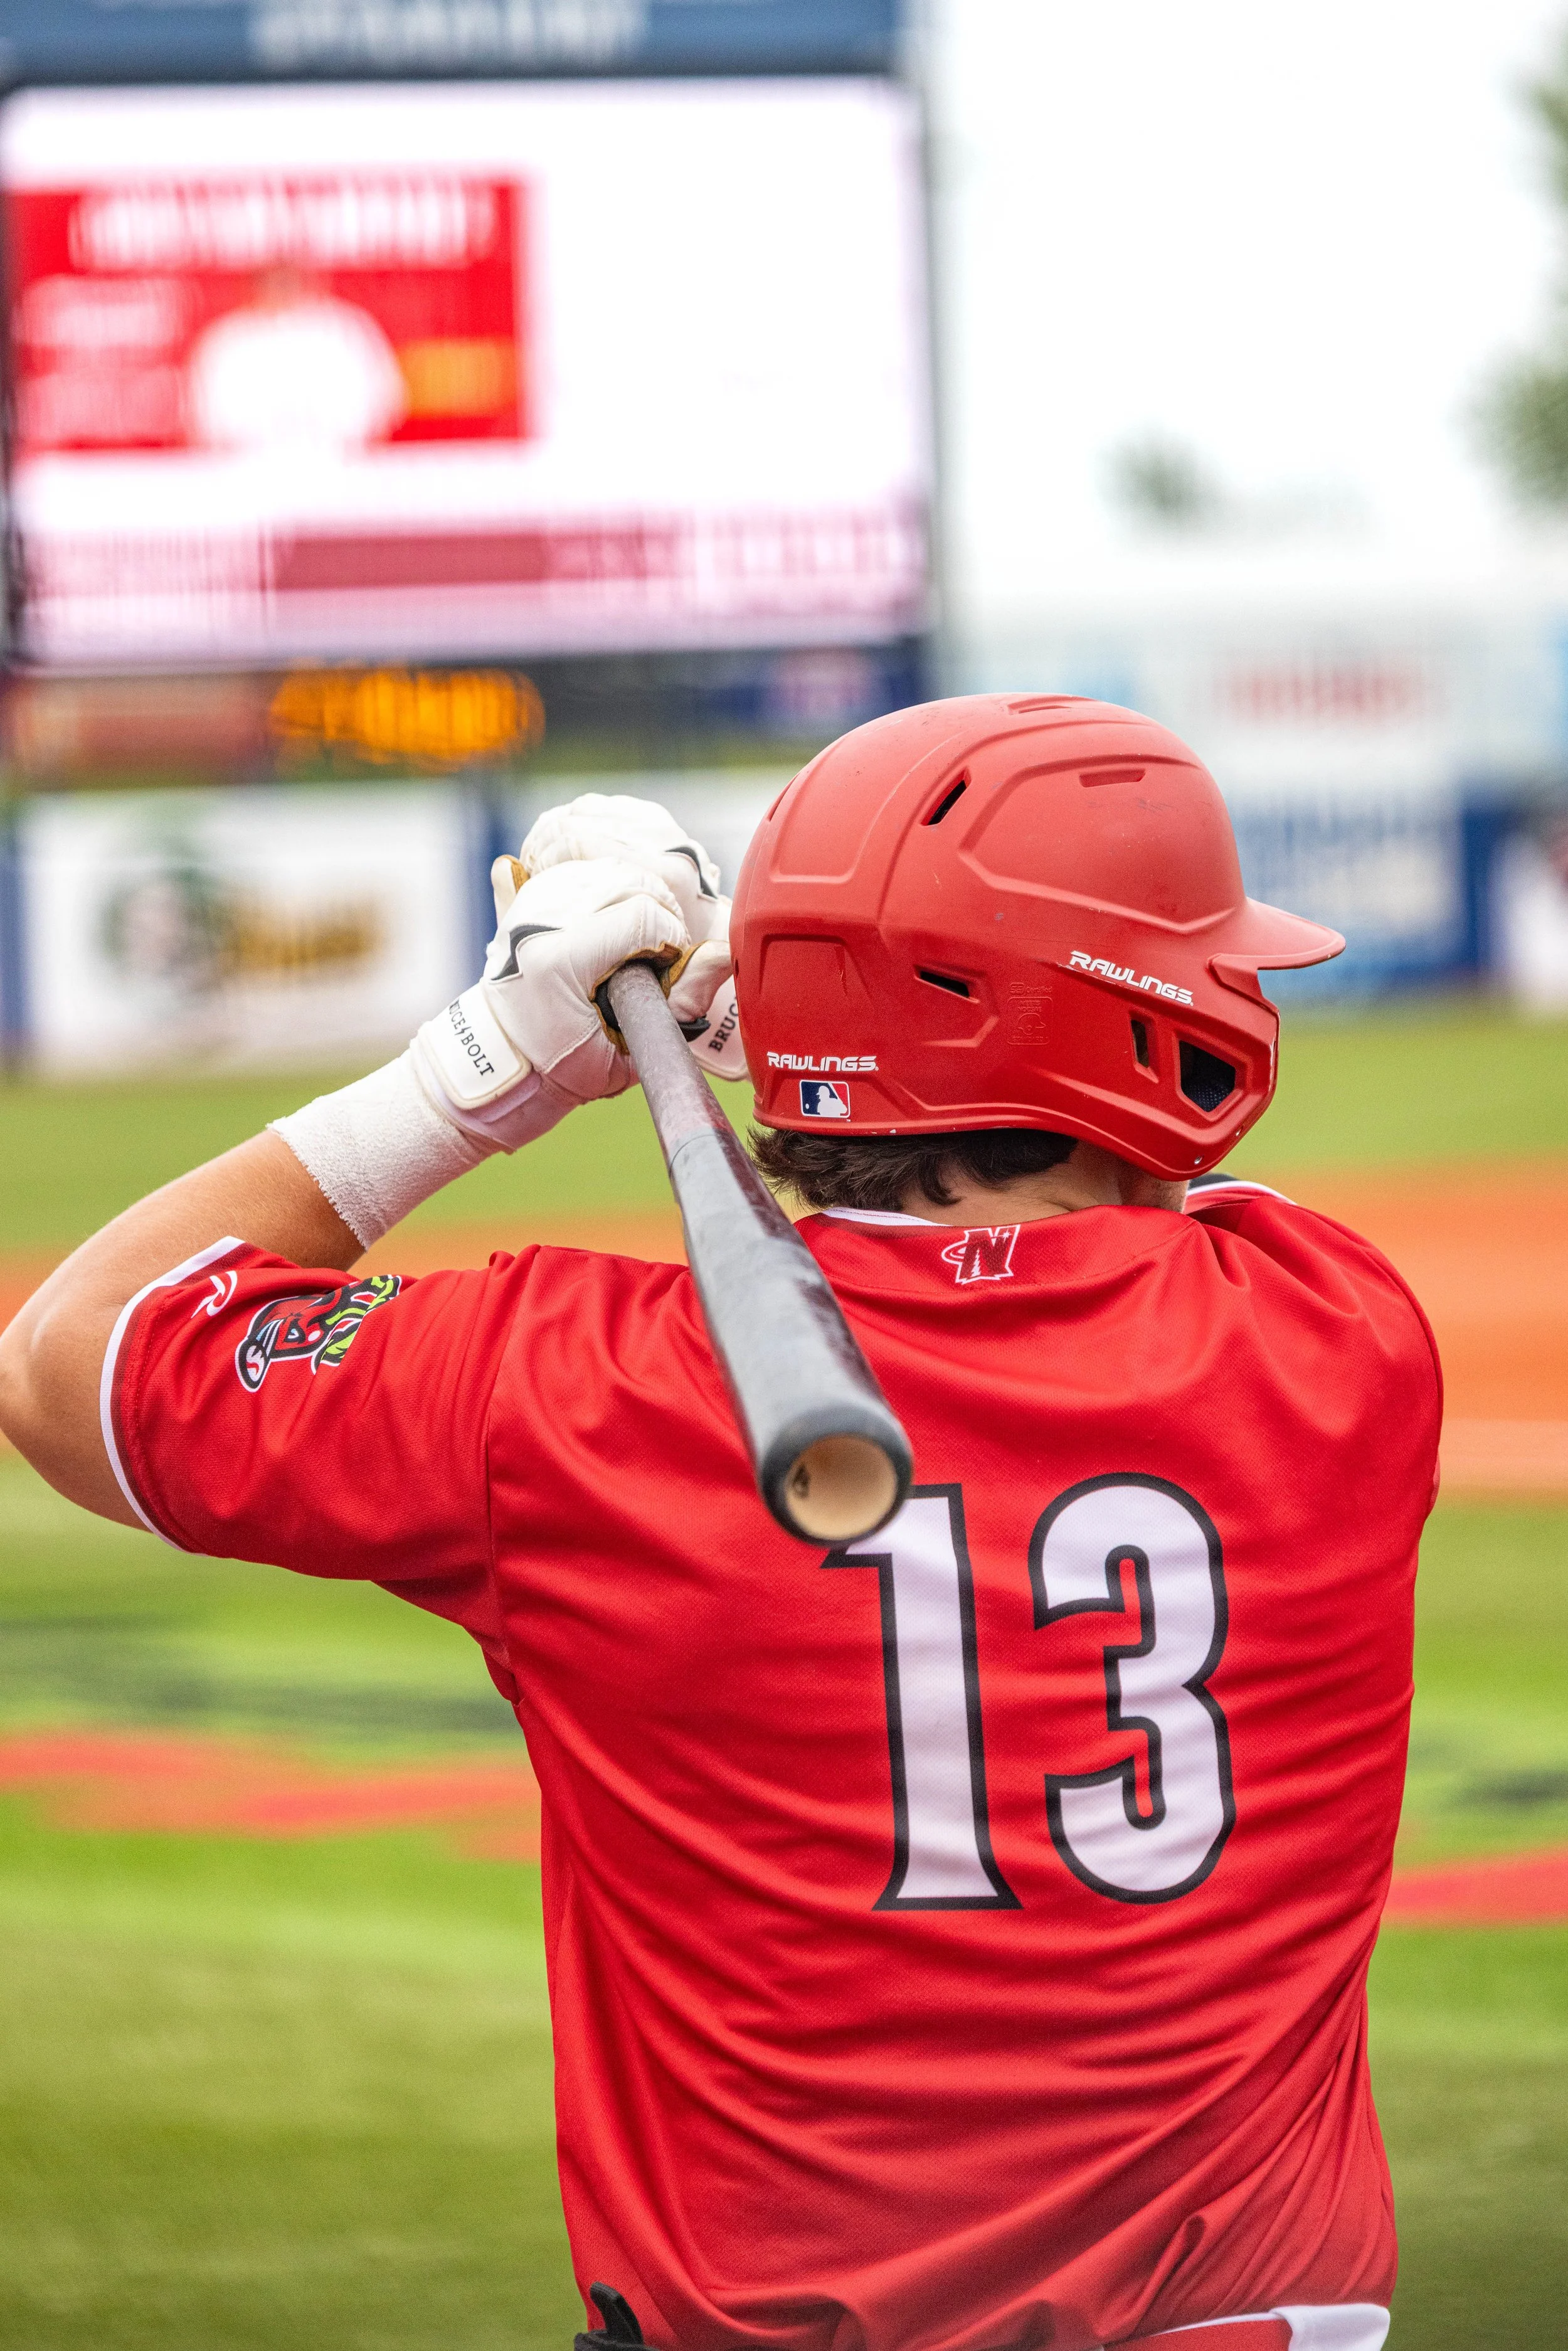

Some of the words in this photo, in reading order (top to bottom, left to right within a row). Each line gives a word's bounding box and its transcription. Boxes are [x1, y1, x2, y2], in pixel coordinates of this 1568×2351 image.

[1070, 950, 1194, 1005] RAWLINGS
[709, 997, 738, 1052] BRUC
[766, 1051, 877, 1071] RAWLINGS
[820, 1472, 1236, 1911] 13
